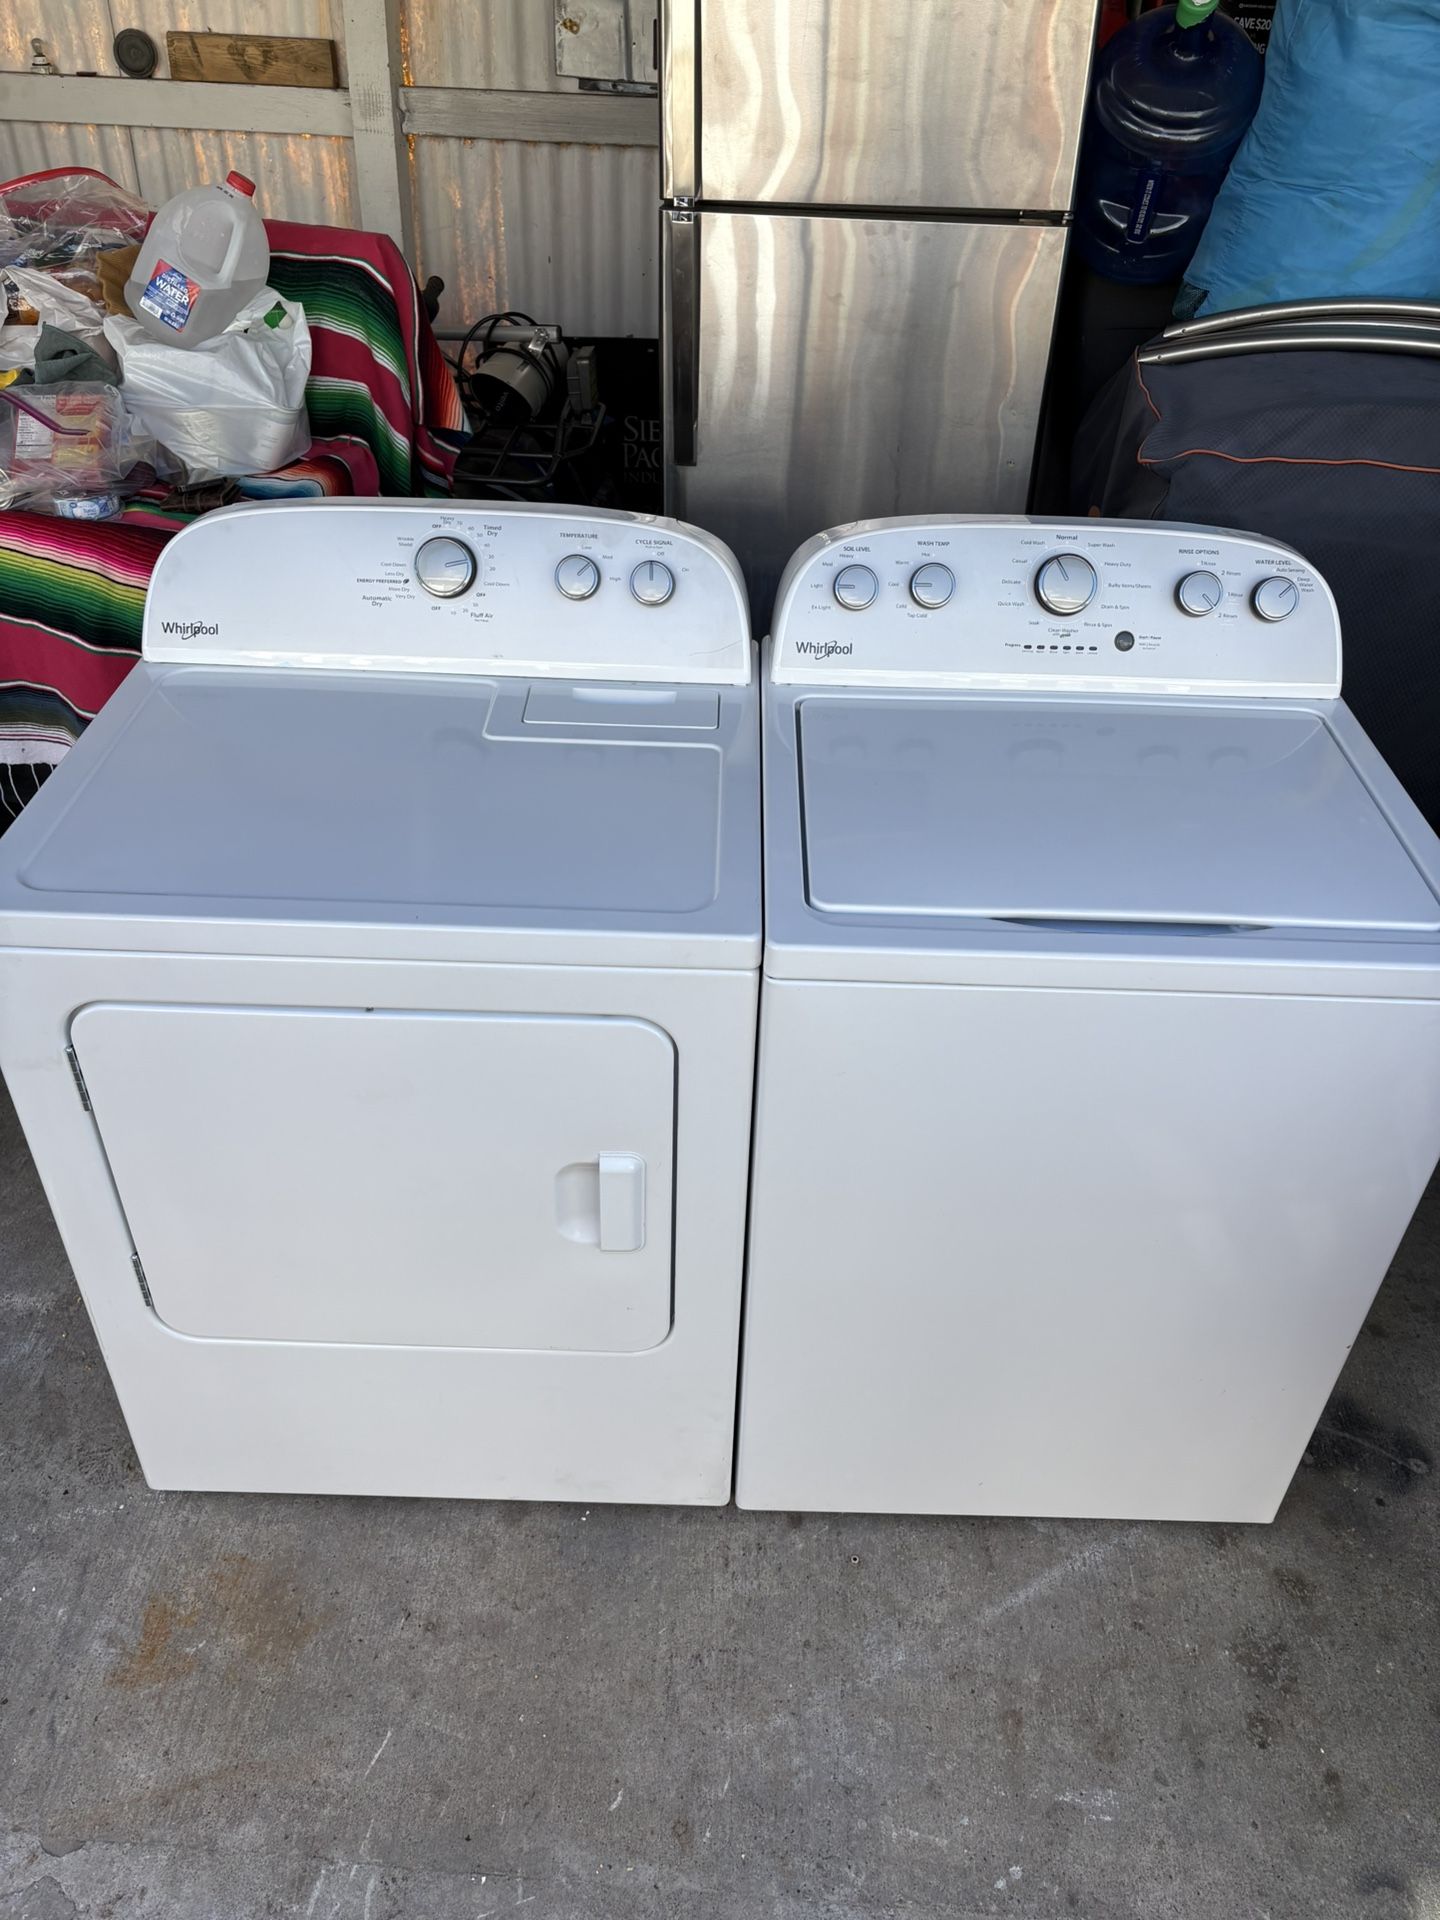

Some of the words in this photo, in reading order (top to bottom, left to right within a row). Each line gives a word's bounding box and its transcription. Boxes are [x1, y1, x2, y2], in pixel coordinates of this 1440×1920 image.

[156, 276, 190, 306] WATER
[161, 620, 219, 640] Whirlpool
[796, 640, 852, 660] Whirlpool
